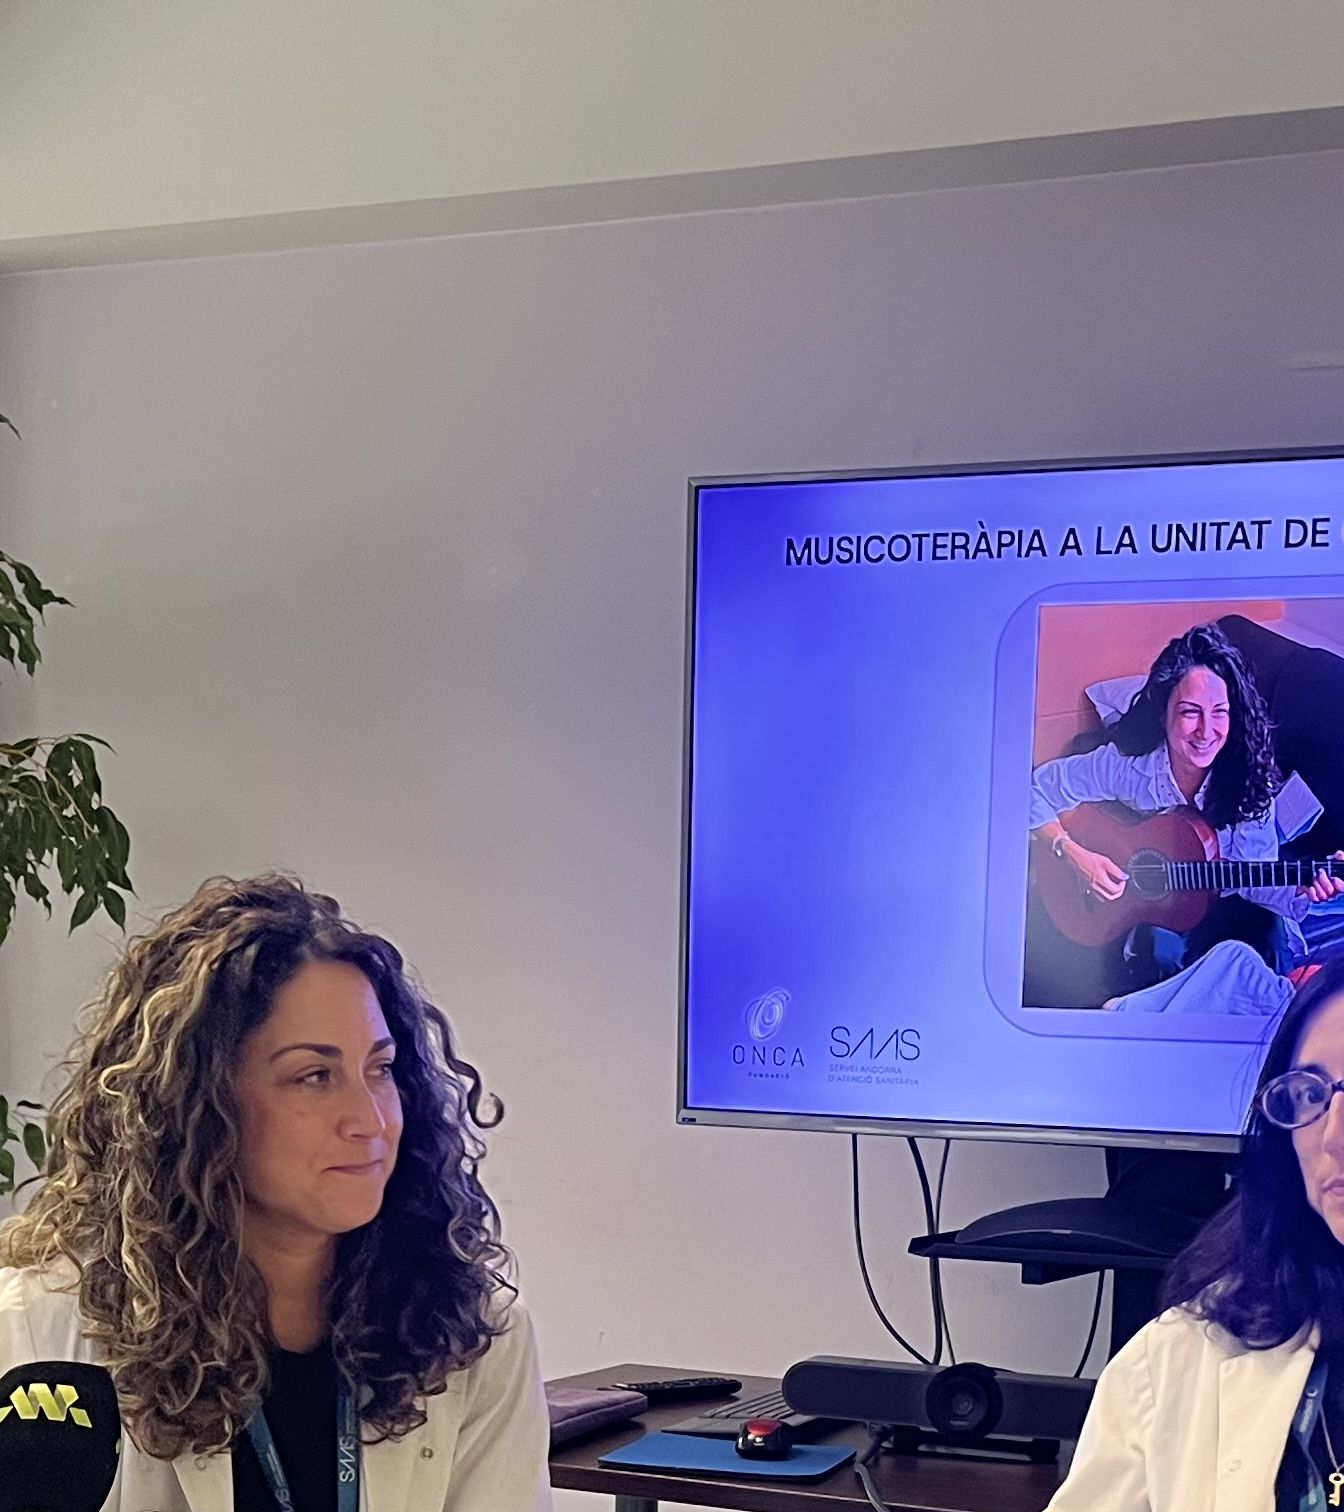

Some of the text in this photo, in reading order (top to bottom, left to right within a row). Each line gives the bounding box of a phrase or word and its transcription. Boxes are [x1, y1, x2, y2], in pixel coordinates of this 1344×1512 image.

[785, 520, 1048, 567] MUSICOTERÀPIA
[1059, 527, 1083, 557] A
[1095, 525, 1138, 556] LA
[1151, 519, 1272, 554] UNITAT
[1284, 517, 1331, 548] DE
[732, 1044, 805, 1068] ONCA
